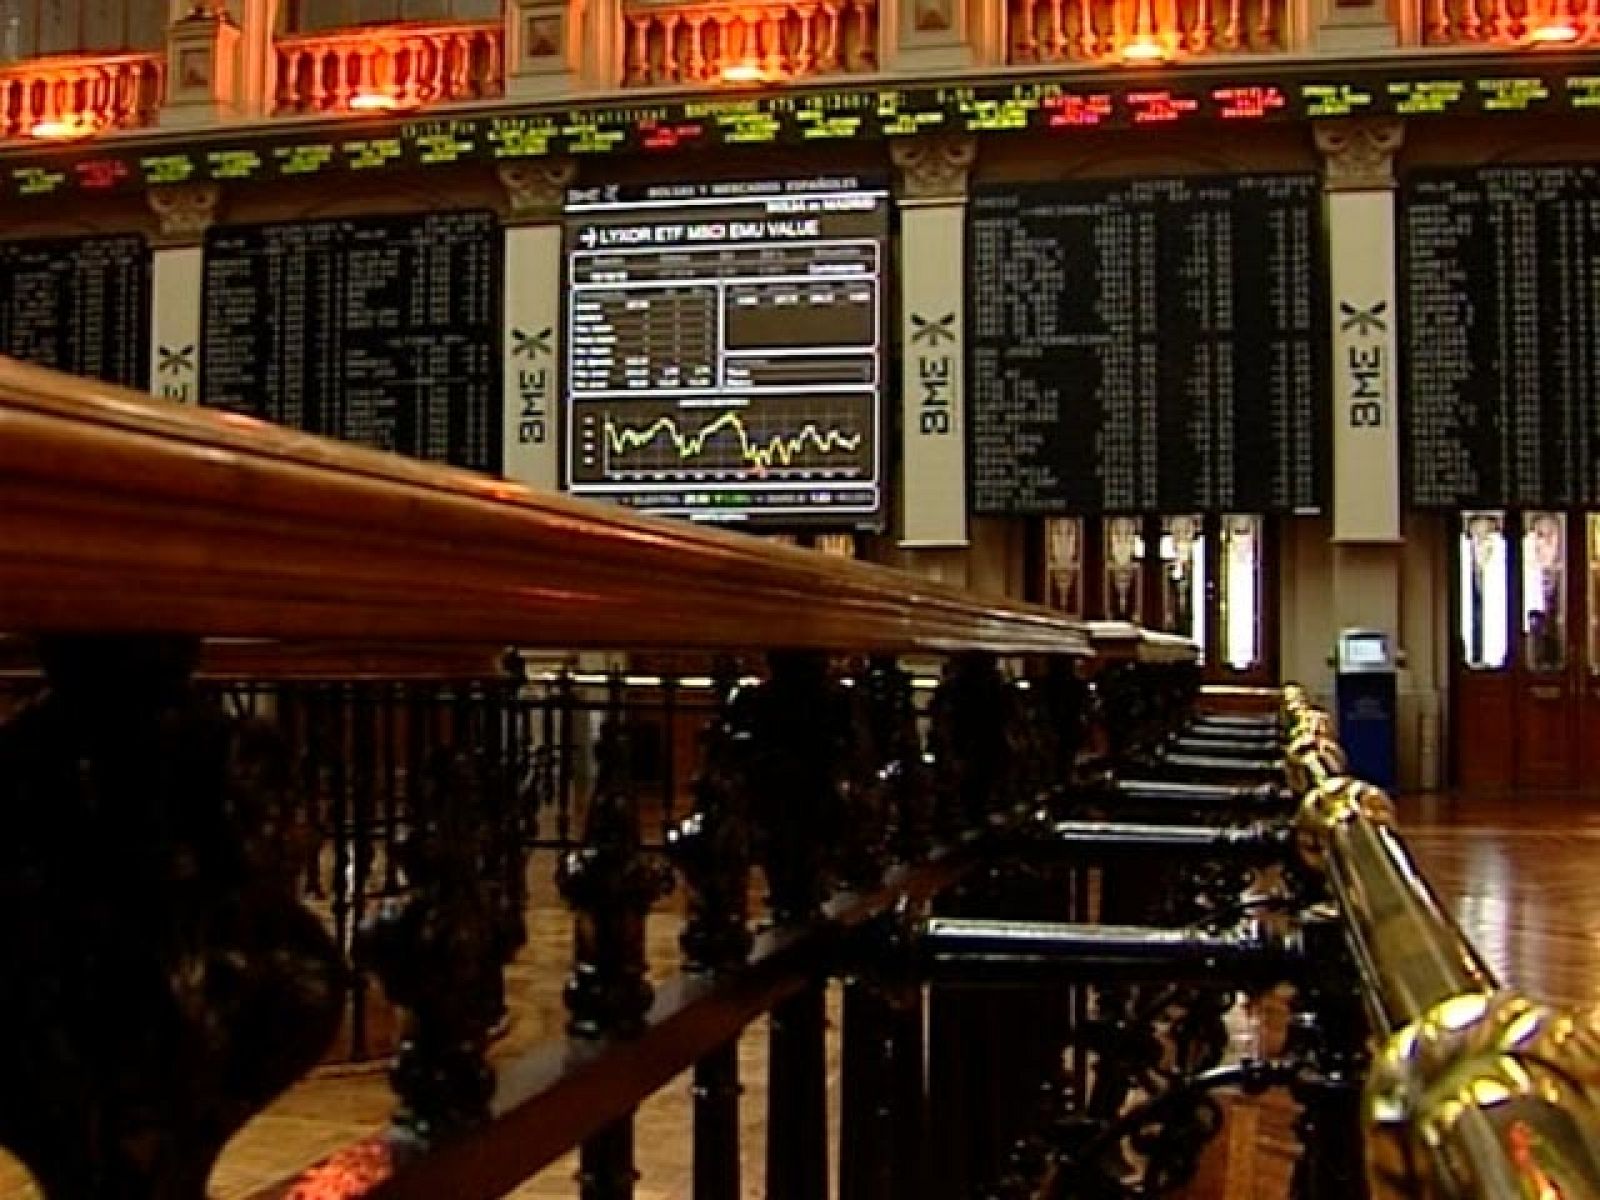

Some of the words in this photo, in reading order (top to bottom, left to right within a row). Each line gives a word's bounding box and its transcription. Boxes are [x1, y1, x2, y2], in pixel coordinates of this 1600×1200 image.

[766, 219, 820, 236] VALUE
[519, 369, 545, 443] BME
[919, 356, 948, 435] BME
[1349, 345, 1380, 427] BME
